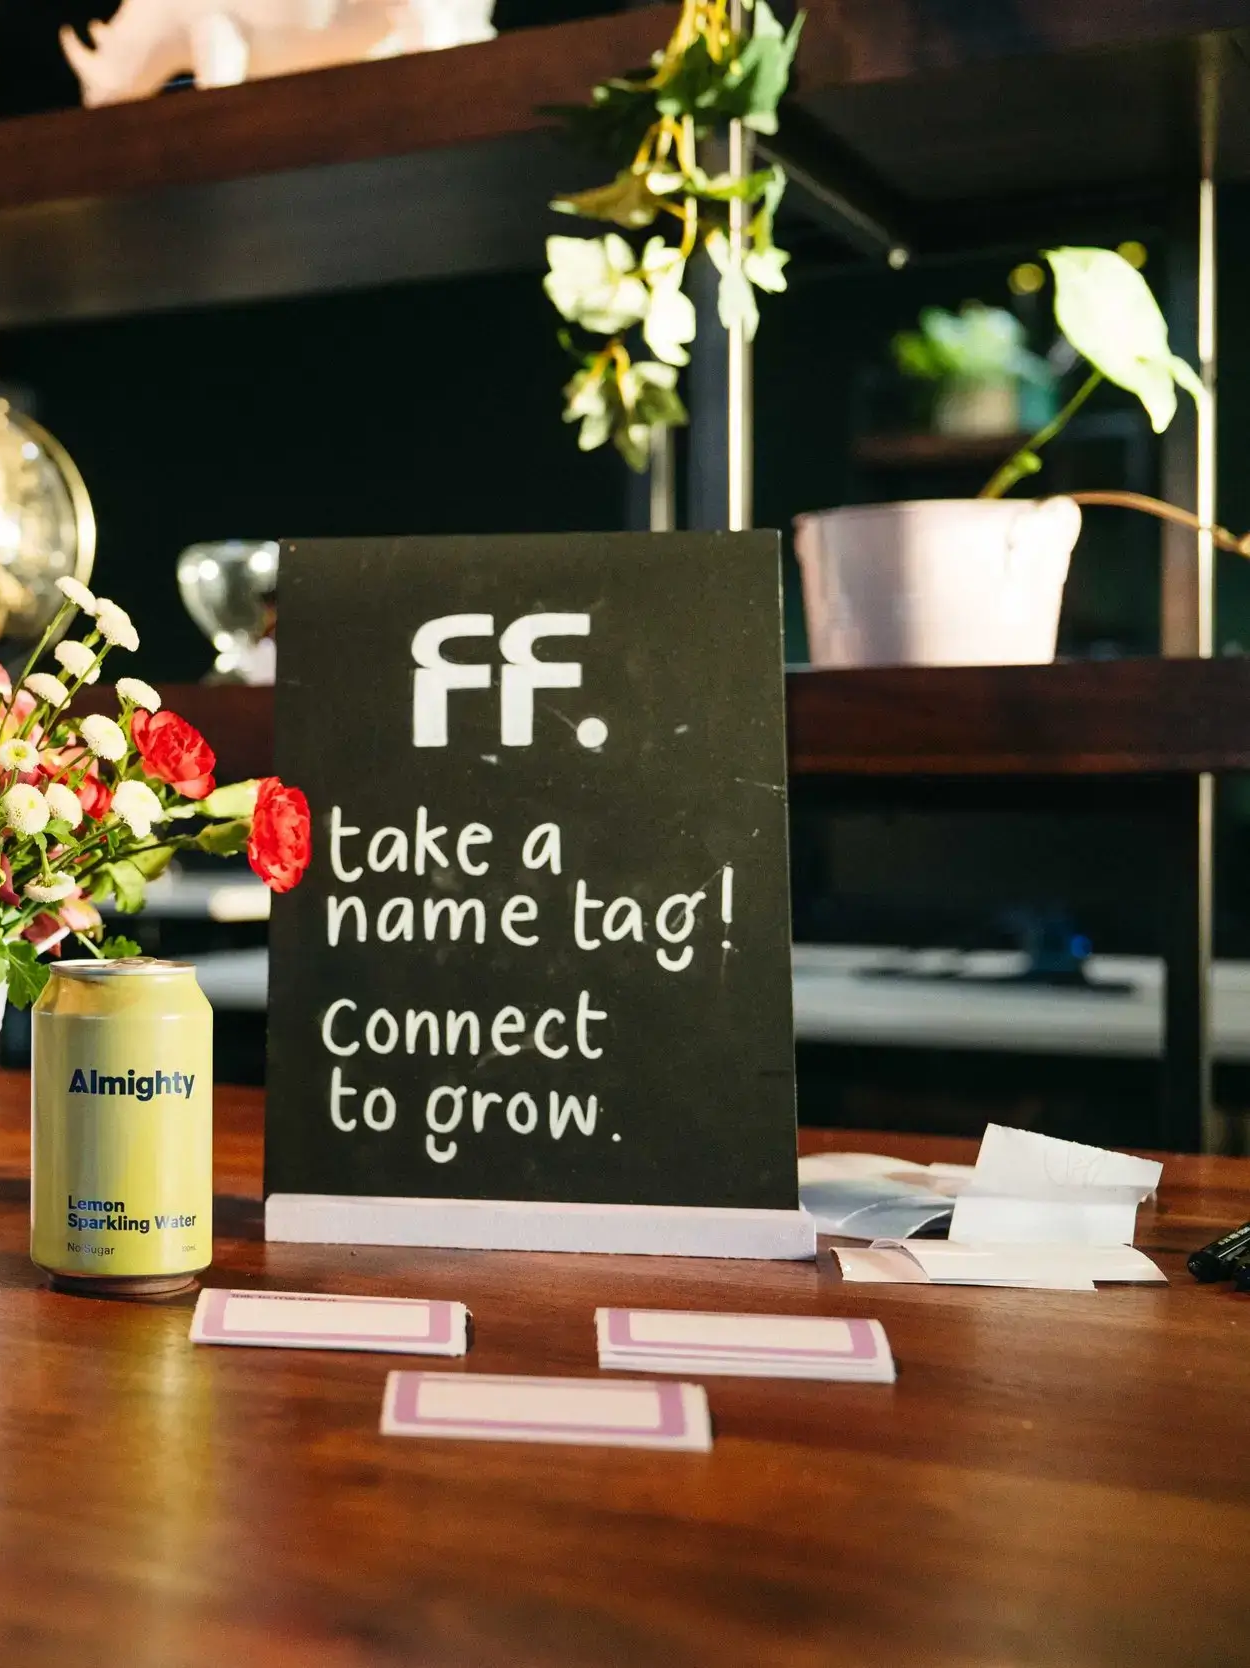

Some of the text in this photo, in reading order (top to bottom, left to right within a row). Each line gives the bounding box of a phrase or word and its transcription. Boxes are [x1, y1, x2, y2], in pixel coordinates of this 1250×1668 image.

[330, 805, 561, 882] take a
[327, 864, 734, 971] name tag!
[68, 1069, 194, 1101] Almighty
[330, 1066, 622, 1163] to grow.
[68, 1195, 124, 1212] Lemon
[68, 1213, 196, 1234] Sparkling Water
[68, 1242, 115, 1256] No Sugar
